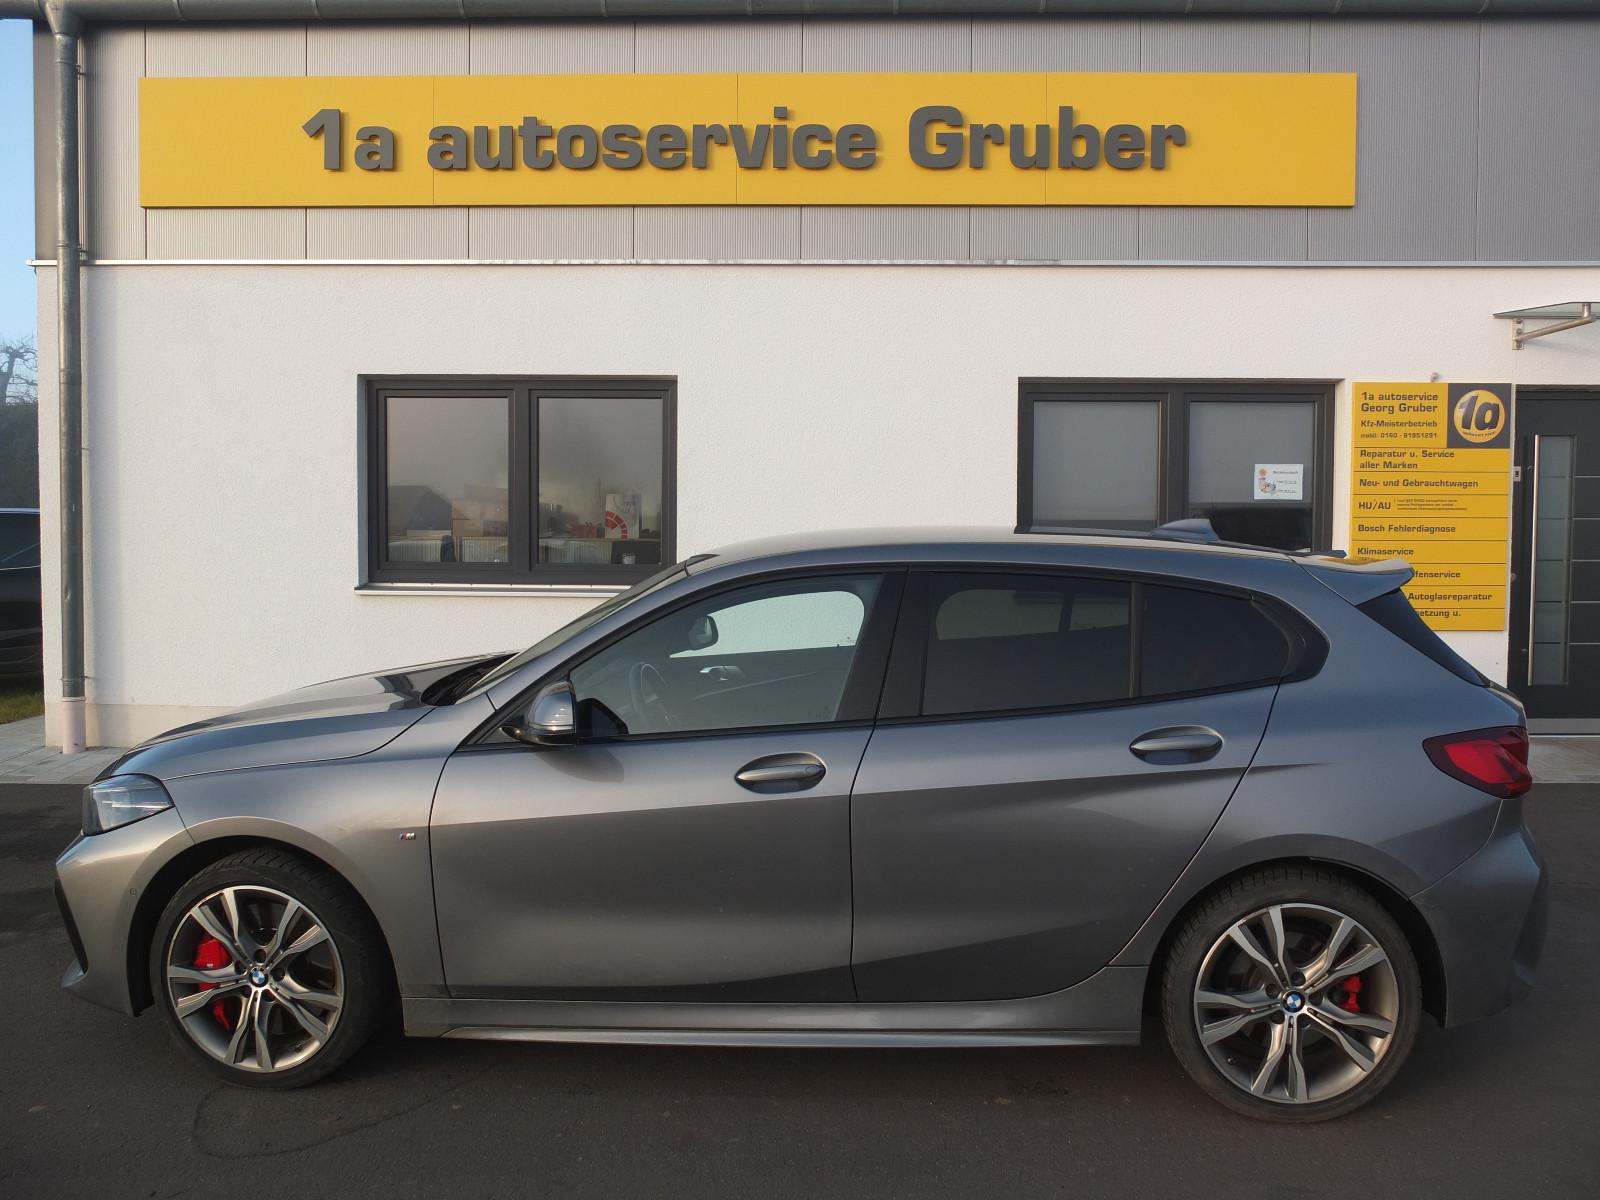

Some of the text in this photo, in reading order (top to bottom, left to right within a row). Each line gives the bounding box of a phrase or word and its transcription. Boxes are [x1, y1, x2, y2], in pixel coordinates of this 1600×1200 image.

[302, 105, 1186, 172] 1a autoservice Gruber
[1361, 392, 1438, 401] 1a autoservice
[1361, 403, 1438, 414] Georg Gruber
[1459, 394, 1500, 431] 1a
[1361, 419, 1437, 428] Kfz-Meisterbetrieb
[1360, 450, 1407, 459] Reparatur
[1422, 450, 1455, 458] Service
[1359, 461, 1418, 469] aller Marken
[1359, 479, 1479, 489] Neu- und Gebrauchtwagen
[1358, 501, 1391, 510] HU/AU
[1358, 524, 1456, 534] Bosch Fehlerdiagnose
[1357, 547, 1414, 555] Klimaservice
[1413, 570, 1461, 578] fenservice
[1407, 593, 1493, 603] Autoglasreparatur
[1418, 610, 1449, 619] etzung
